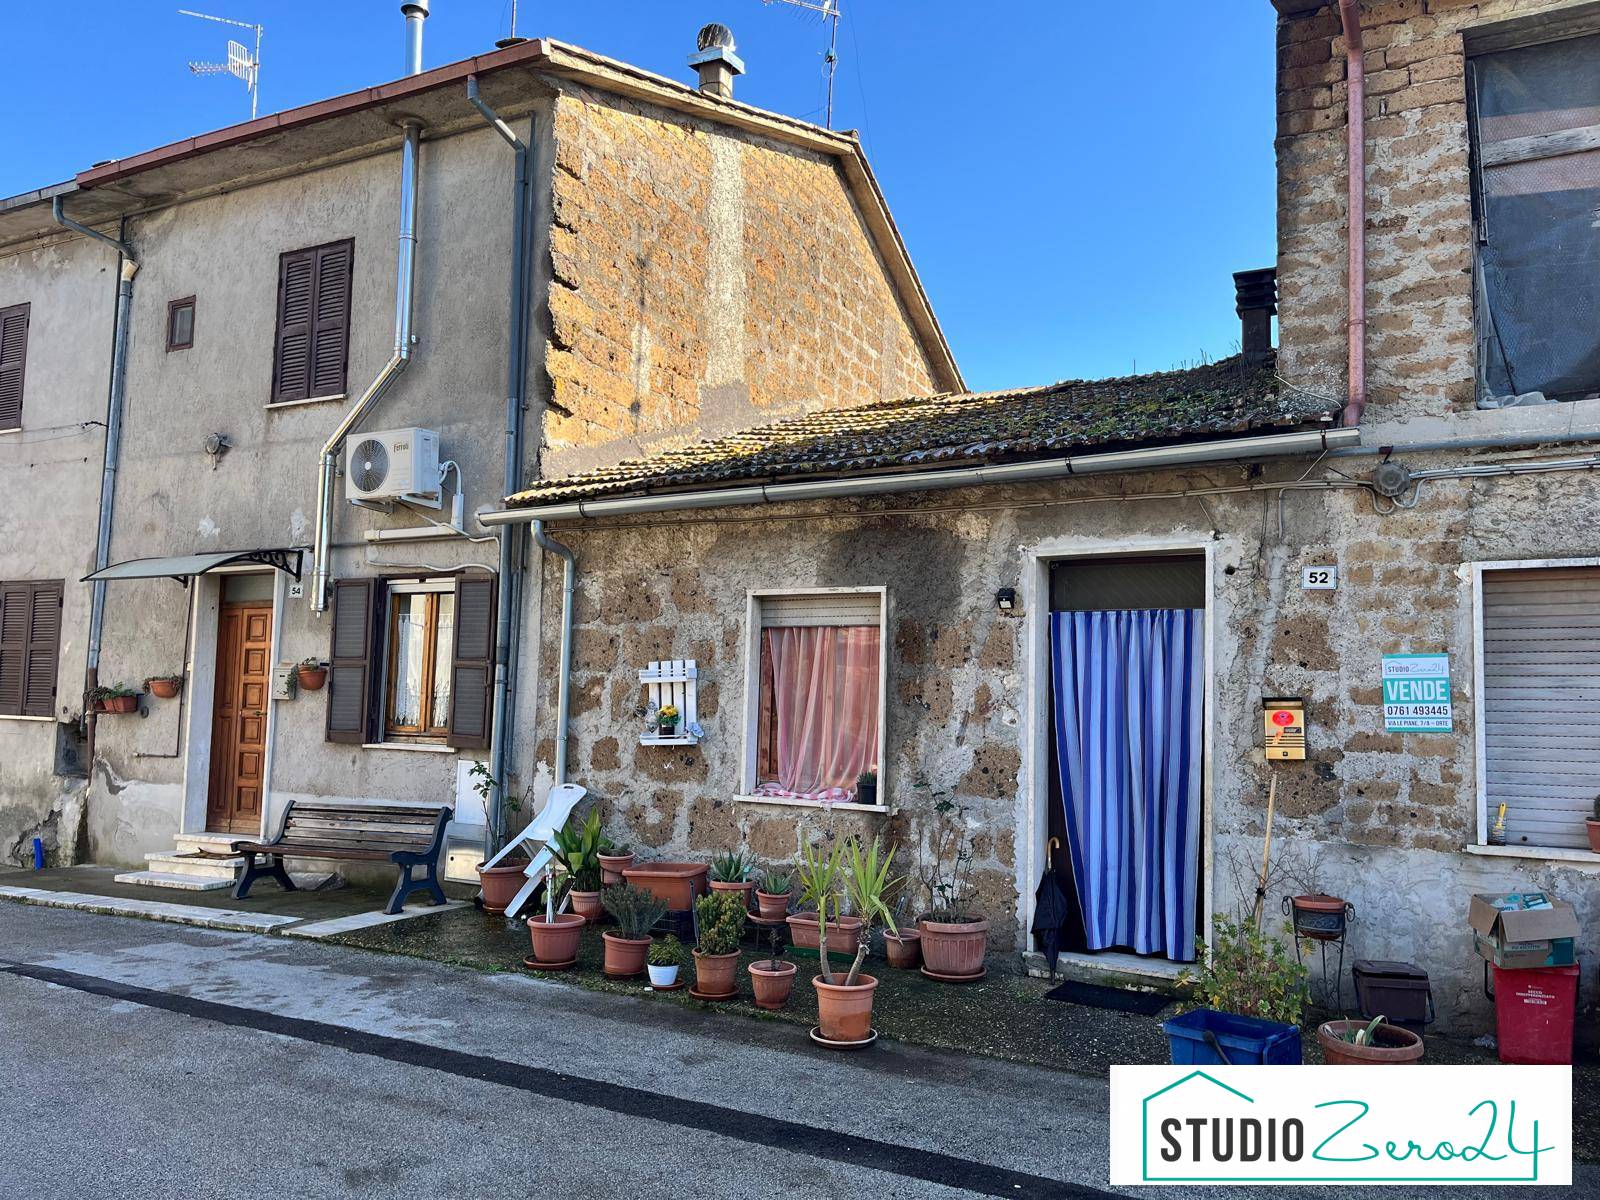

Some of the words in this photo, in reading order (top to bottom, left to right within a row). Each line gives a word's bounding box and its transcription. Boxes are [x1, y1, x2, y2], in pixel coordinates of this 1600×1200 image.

[1309, 571, 1329, 584] 52
[292, 586, 301, 595] 54
[1386, 680, 1447, 701] VENDE
[1387, 705, 1410, 715] 0761
[1413, 705, 1448, 715] 493445
